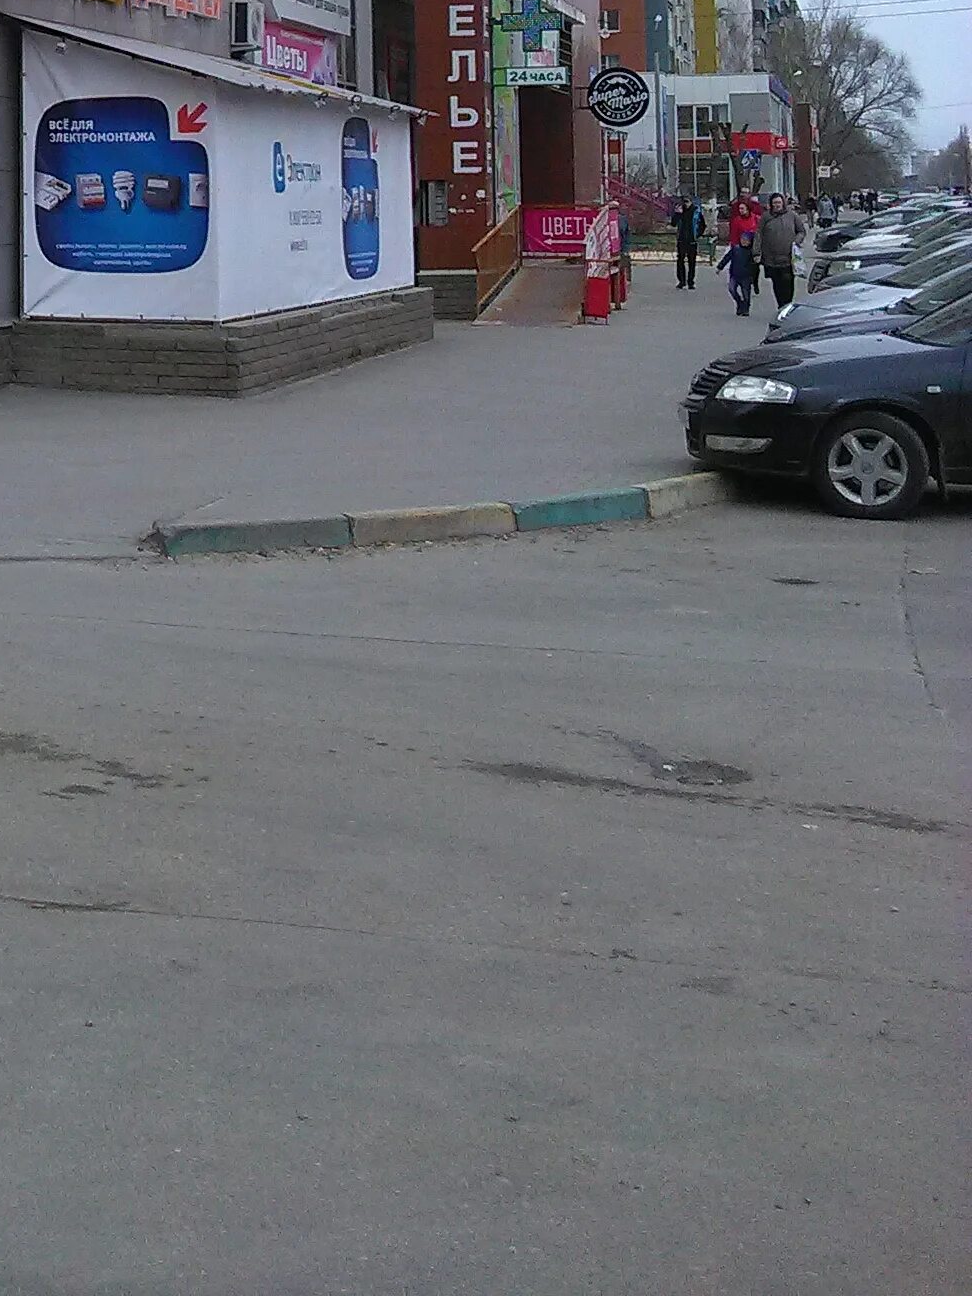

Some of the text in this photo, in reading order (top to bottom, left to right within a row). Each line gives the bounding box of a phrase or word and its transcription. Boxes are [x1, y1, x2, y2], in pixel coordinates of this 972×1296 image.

[509, 71, 528, 83] 24
[48, 118, 94, 132] ВСЁ ДЛЯ
[48, 131, 157, 144] ЭЛЕКТРОМОНТАЖА
